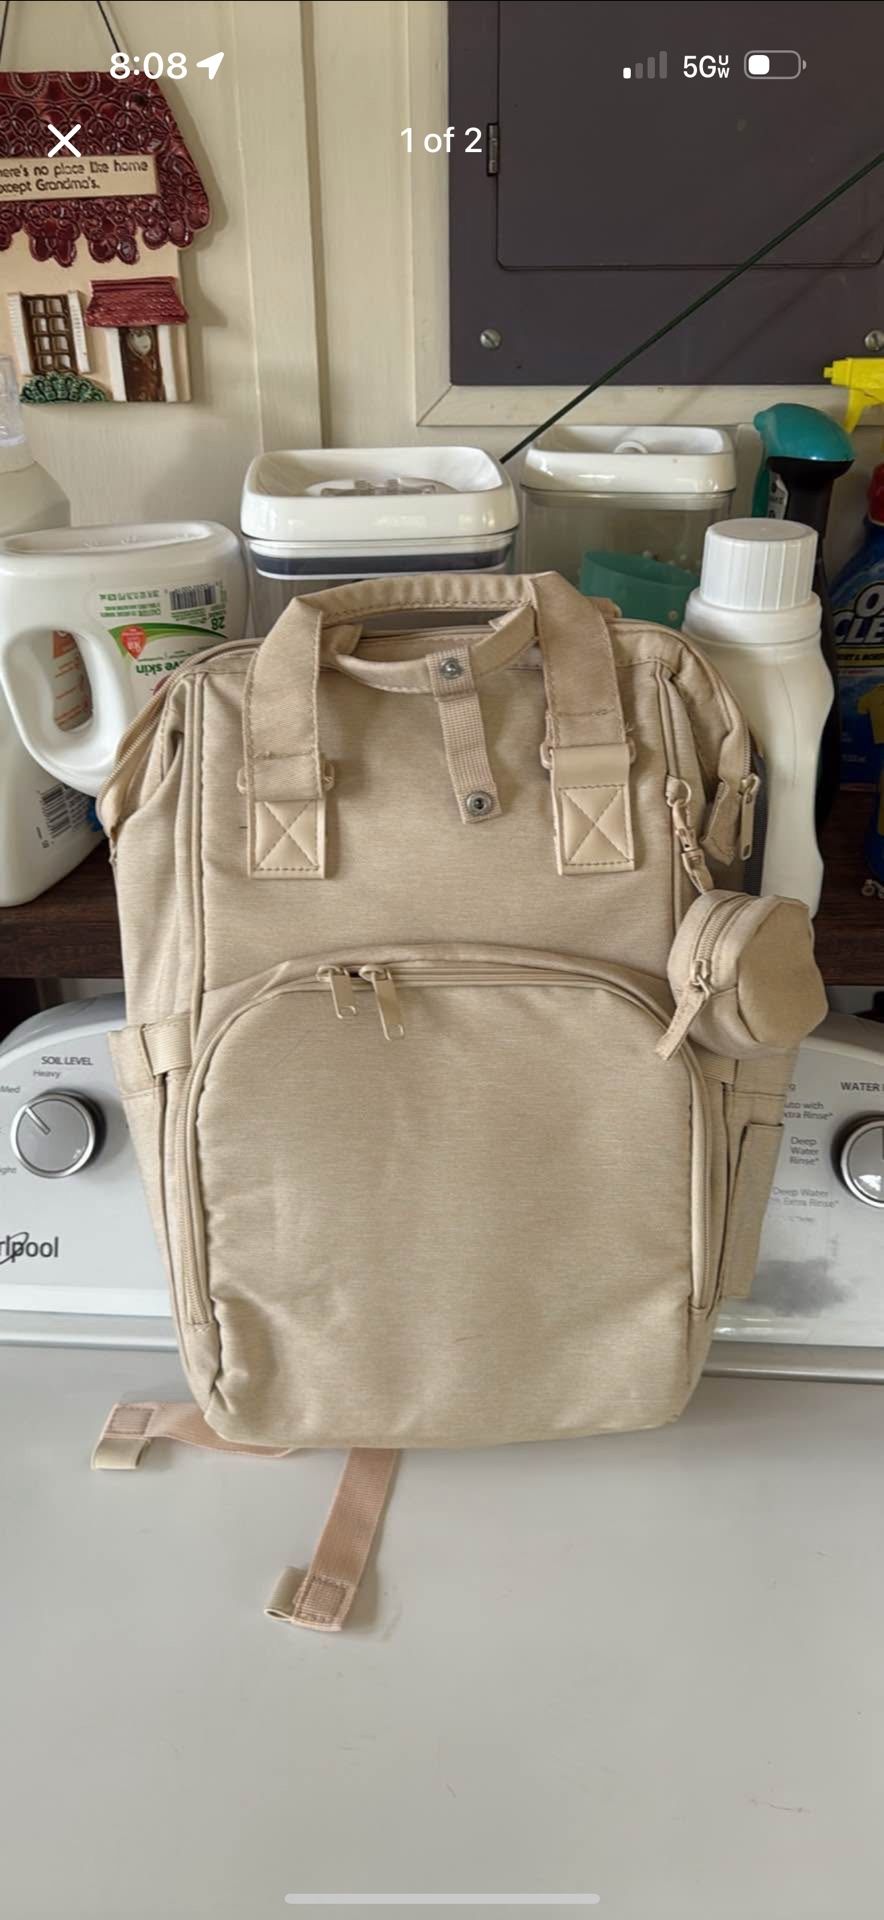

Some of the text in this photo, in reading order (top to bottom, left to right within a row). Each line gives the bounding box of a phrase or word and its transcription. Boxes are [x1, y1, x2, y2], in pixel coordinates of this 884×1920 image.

[33, 165, 49, 177] no
[54, 162, 85, 178] place
[113, 159, 149, 172] home
[211, 615, 226, 631] 28
[135, 662, 164, 676] skin
[41, 1056, 94, 1067] SOIL LEVEL
[33, 1068, 62, 1080] Heavy
[840, 1081, 880, 1093] WATER
[790, 1136, 817, 1147] Deep
